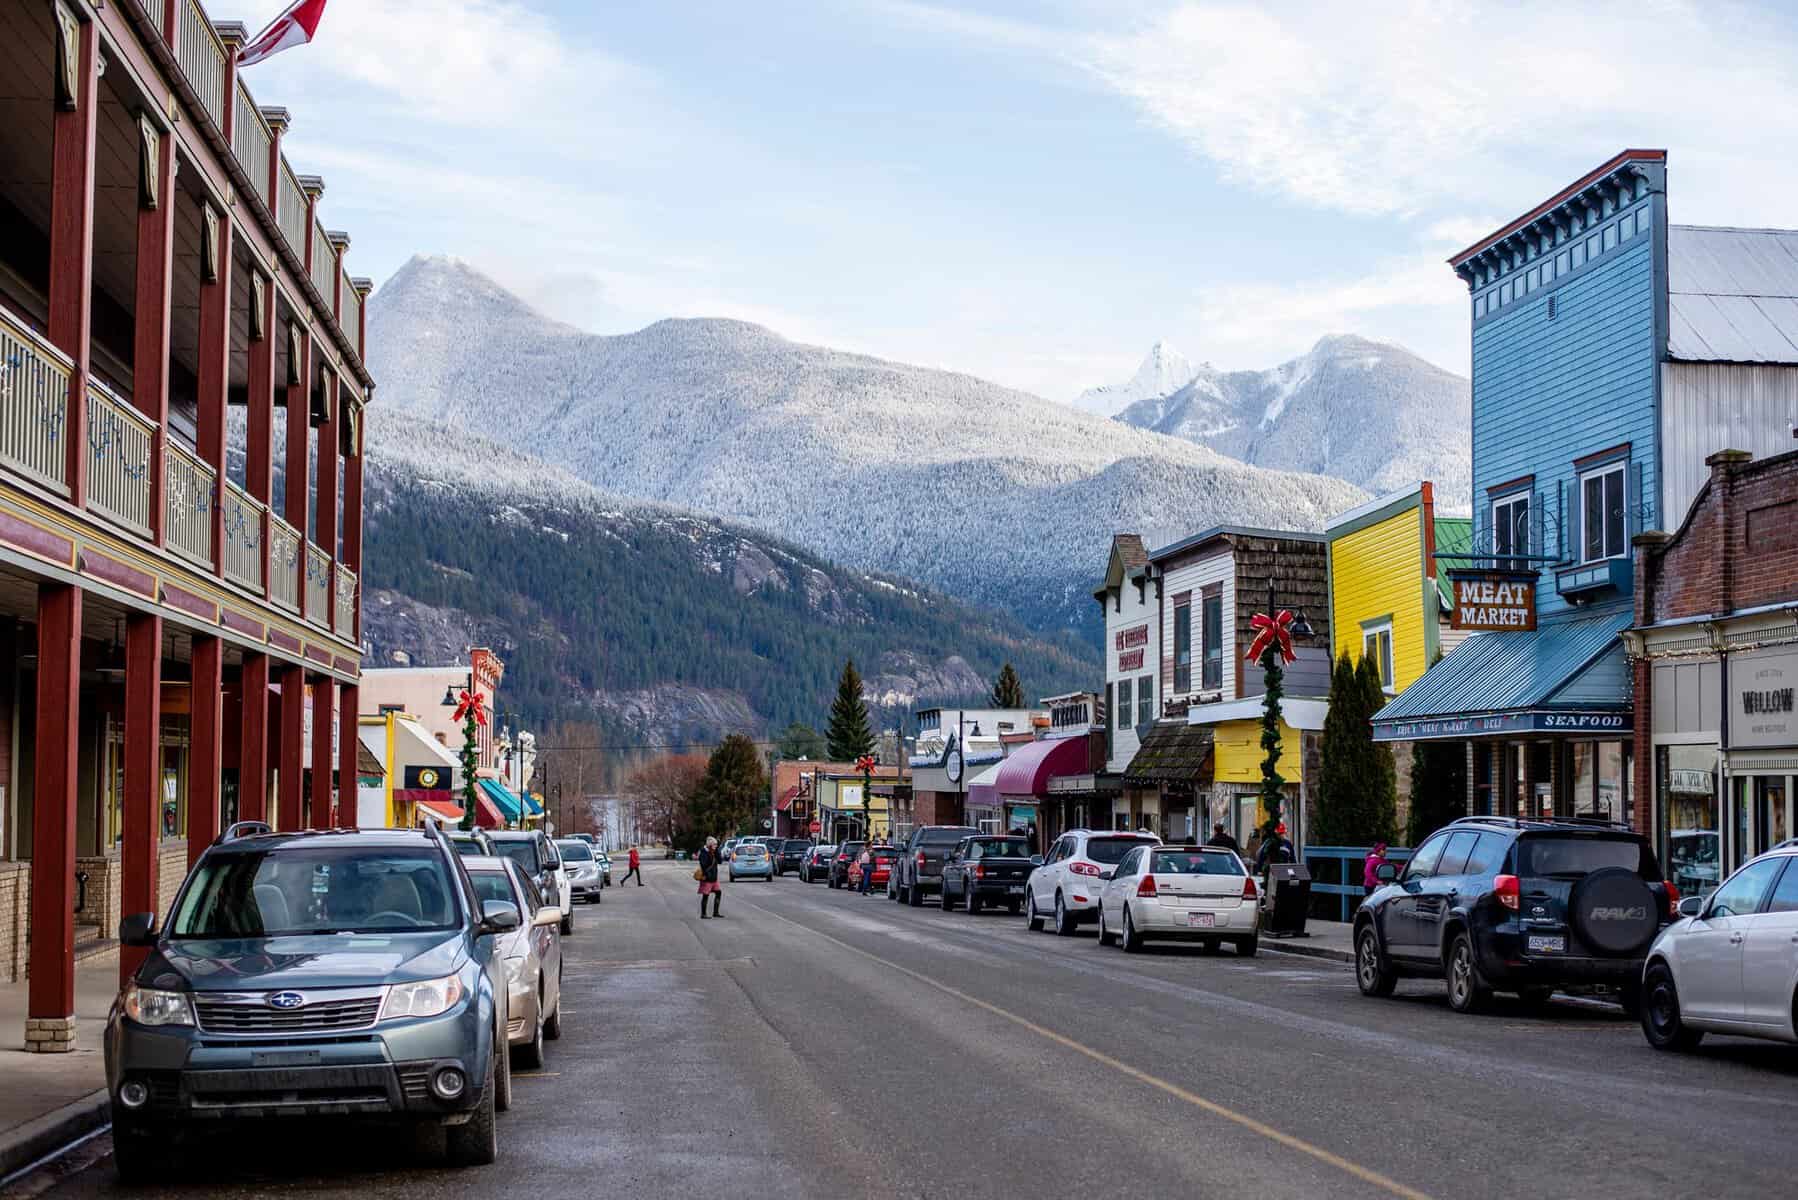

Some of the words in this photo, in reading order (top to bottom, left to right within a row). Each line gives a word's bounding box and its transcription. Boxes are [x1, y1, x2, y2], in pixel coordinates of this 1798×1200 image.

[1460, 580, 1528, 604] MEAT
[1460, 607, 1528, 625] MARKET
[1742, 687, 1793, 714] WILLOW
[1544, 715, 1623, 727] SEAFOOD
[1590, 906, 1646, 921] RAV4
